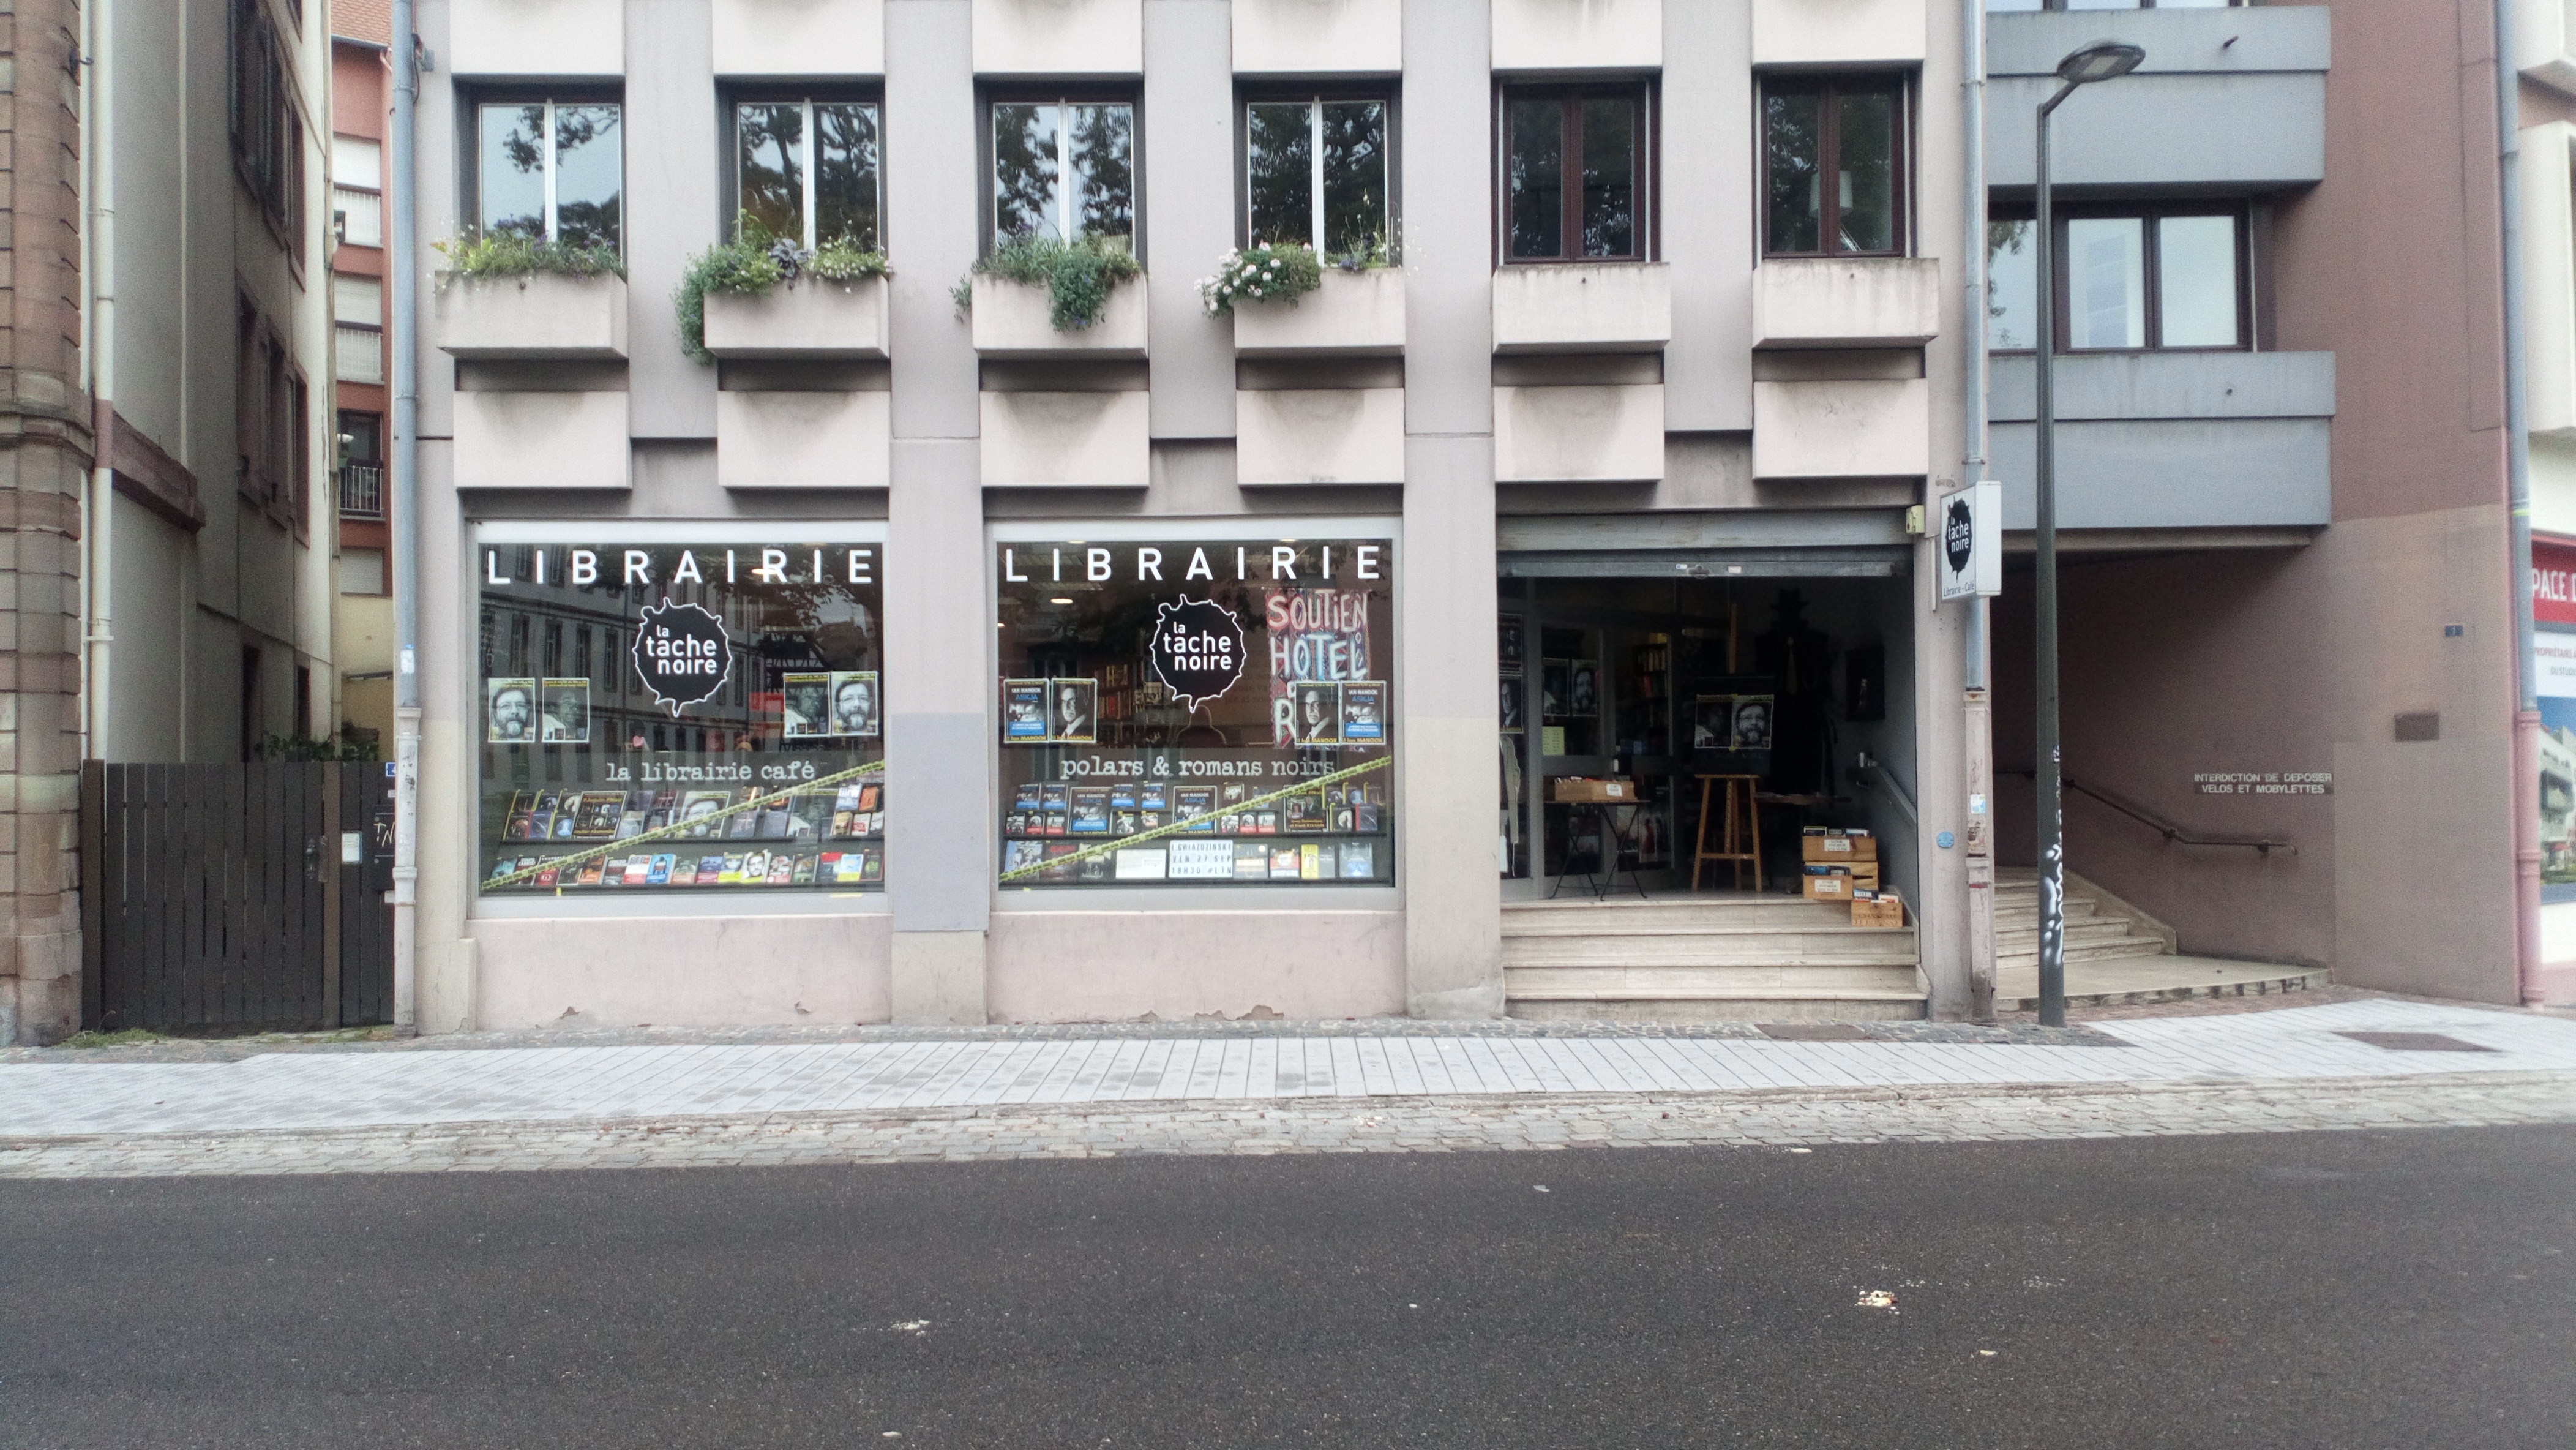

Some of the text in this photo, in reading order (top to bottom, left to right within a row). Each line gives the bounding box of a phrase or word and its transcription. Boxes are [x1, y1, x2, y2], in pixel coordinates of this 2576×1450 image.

[1948, 520, 1969, 540] tache
[1951, 538, 1969, 553] noire
[489, 550, 872, 584] LIBRAIRIE
[1006, 546, 1379, 582] LIBRAIRIE
[1268, 589, 1368, 633] SOUTIEN
[657, 625, 669, 637] la
[1174, 622, 1185, 634] la
[646, 633, 717, 658] tache
[1164, 630, 1232, 653] tache
[657, 657, 717, 674] noire
[1174, 654, 1232, 671] noire
[605, 762, 631, 781] la
[640, 762, 752, 781] librairie
[760, 761, 816, 780] café
[1060, 755, 1144, 780] polars
[1153, 756, 1170, 776] &
[1178, 760, 1262, 776] romans
[1271, 757, 1335, 776] noirs
[2194, 773, 2332, 783] INTERDICTION DE DEPOSER
[2201, 784, 2325, 794] VELOS ET MOBYLETTES
